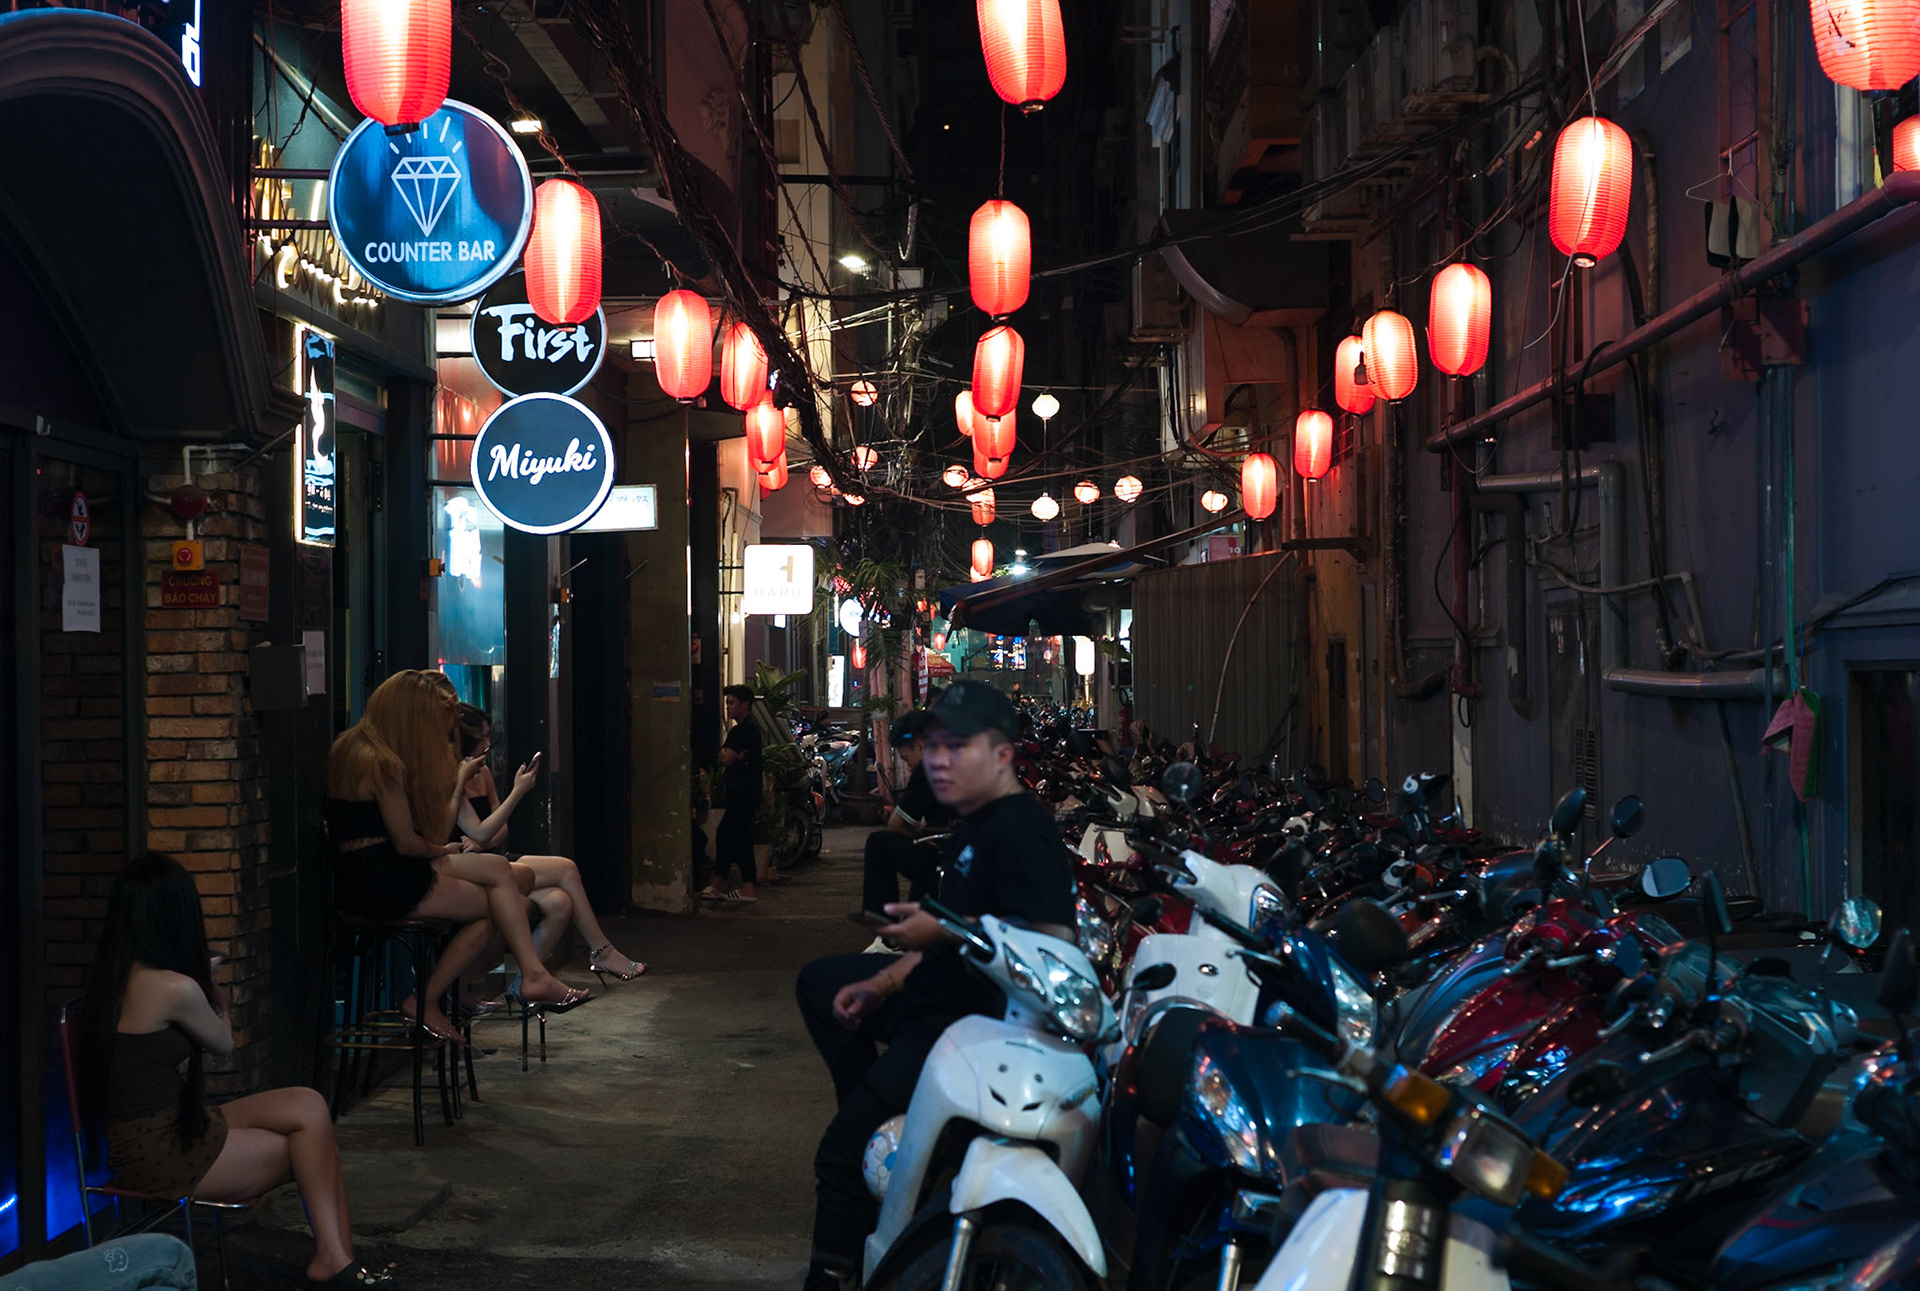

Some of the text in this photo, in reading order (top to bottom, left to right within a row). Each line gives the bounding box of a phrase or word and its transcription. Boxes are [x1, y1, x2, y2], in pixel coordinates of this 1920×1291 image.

[365, 240, 496, 263] COUNTER BAR
[480, 303, 594, 363] First
[488, 437, 597, 485] Miyuki
[753, 587, 801, 599] HARU
